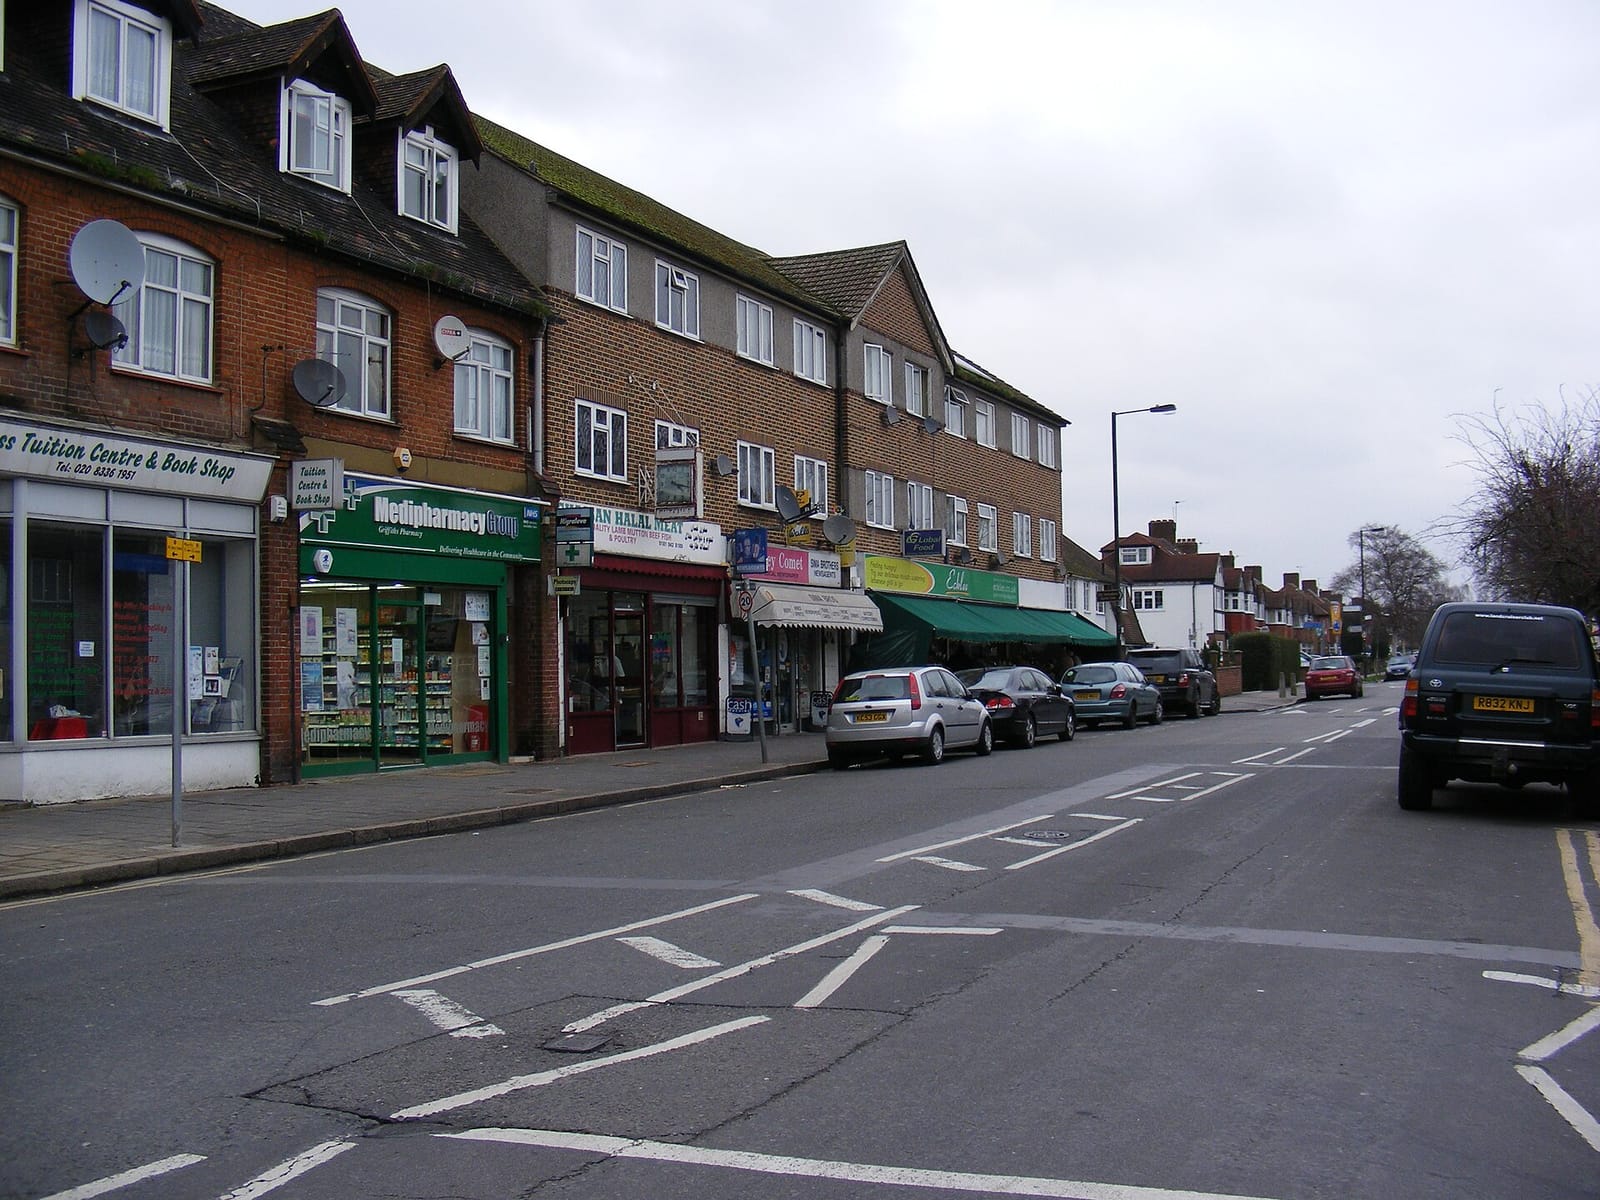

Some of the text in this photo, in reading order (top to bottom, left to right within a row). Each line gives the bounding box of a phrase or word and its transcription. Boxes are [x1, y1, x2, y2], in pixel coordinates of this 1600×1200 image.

[21, 432, 86, 460] Tuition
[90, 445, 144, 467] Centre
[145, 450, 158, 470] &
[162, 453, 198, 475] Book
[200, 458, 237, 484] Shop
[74, 464, 92, 475] 020
[93, 467, 115, 478] 8336
[117, 469, 137, 481] 1951
[299, 466, 327, 477] Tuition
[298, 479, 328, 490] Centre &
[295, 493, 331, 506] Book Shop
[374, 496, 519, 539] Medipharmacy Group
[526, 508, 539, 518] NHS
[615, 511, 652, 530] HALAL
[654, 518, 683, 534] MEAT
[399, 526, 423, 538] Pharmacy
[611, 525, 626, 535] LAMB
[627, 527, 648, 538] MUTTON
[649, 530, 660, 539] BEEF
[613, 535, 637, 545] POULTRY
[439, 545, 463, 556] Delivering
[913, 543, 934, 551] Food
[779, 551, 803, 571] Comet
[741, 597, 751, 606] 20
[728, 699, 752, 710] cash
[1478, 699, 1530, 710] R832 KNJ
